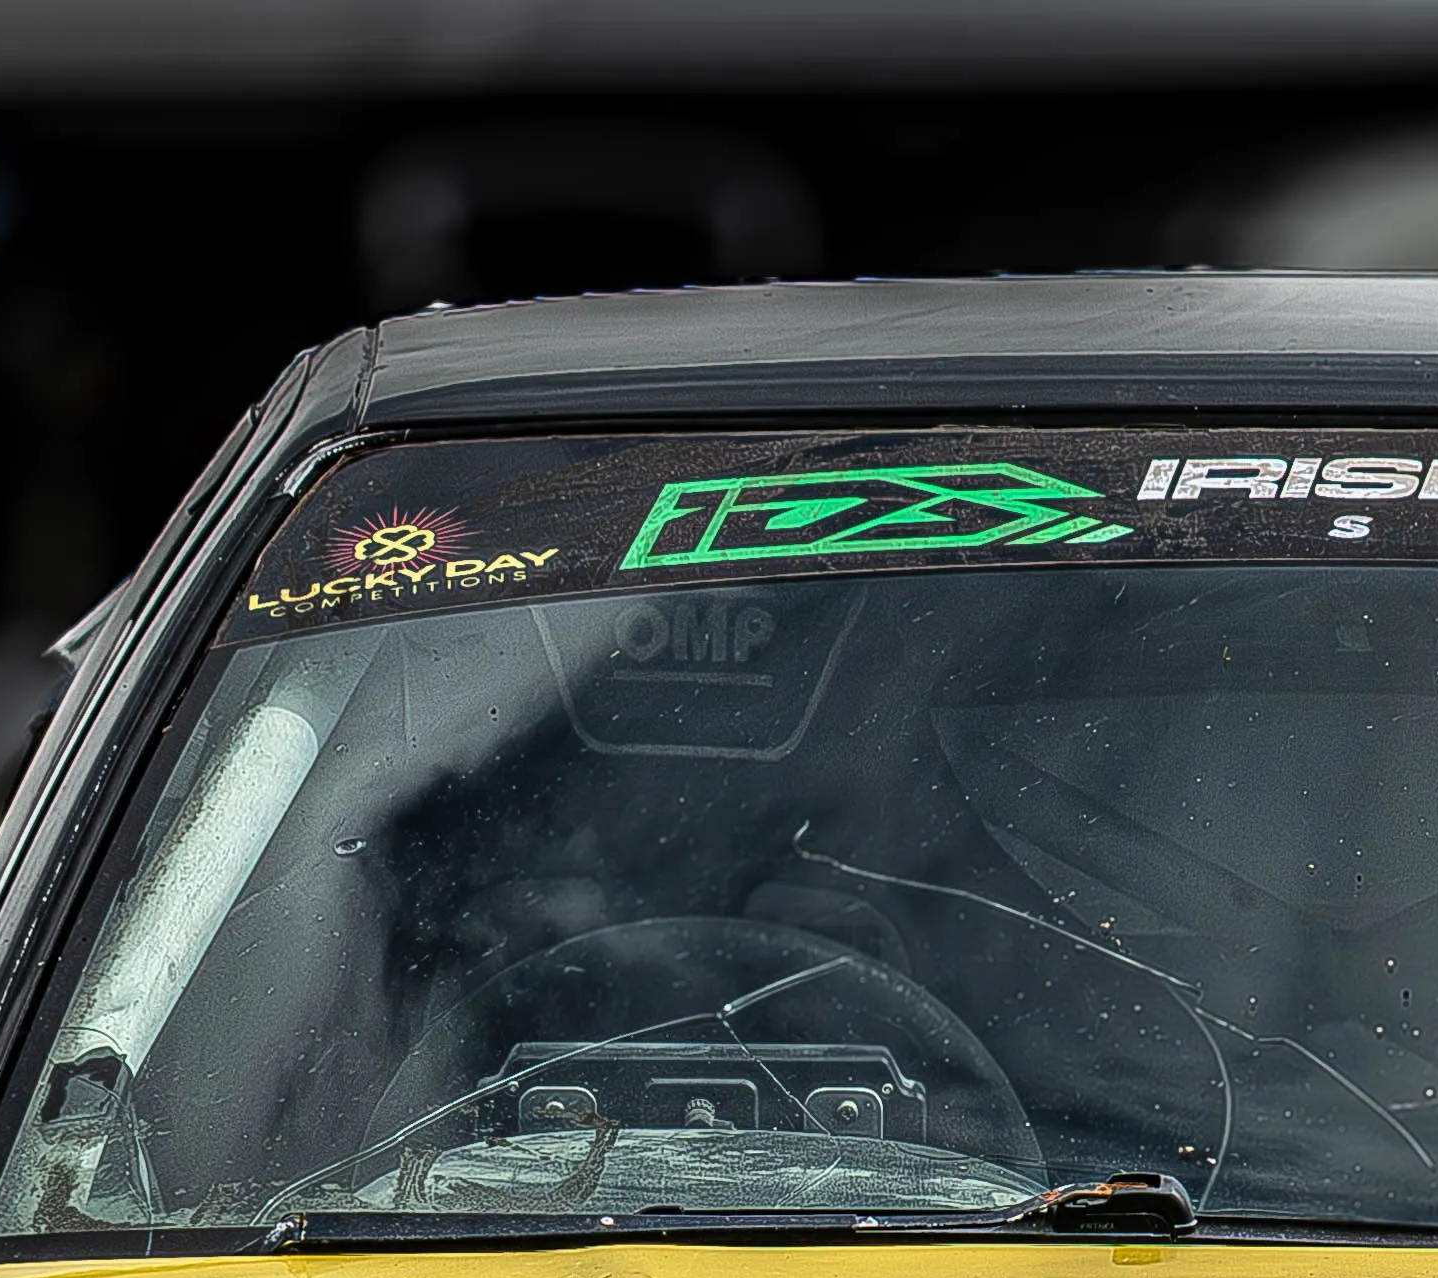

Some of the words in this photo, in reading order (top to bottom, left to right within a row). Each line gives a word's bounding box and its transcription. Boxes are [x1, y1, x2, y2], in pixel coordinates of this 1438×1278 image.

[247, 563, 436, 612] LUCKY
[445, 547, 560, 578] DAY
[269, 569, 528, 618] COMPETITIONS
[614, 602, 776, 663] OMP
